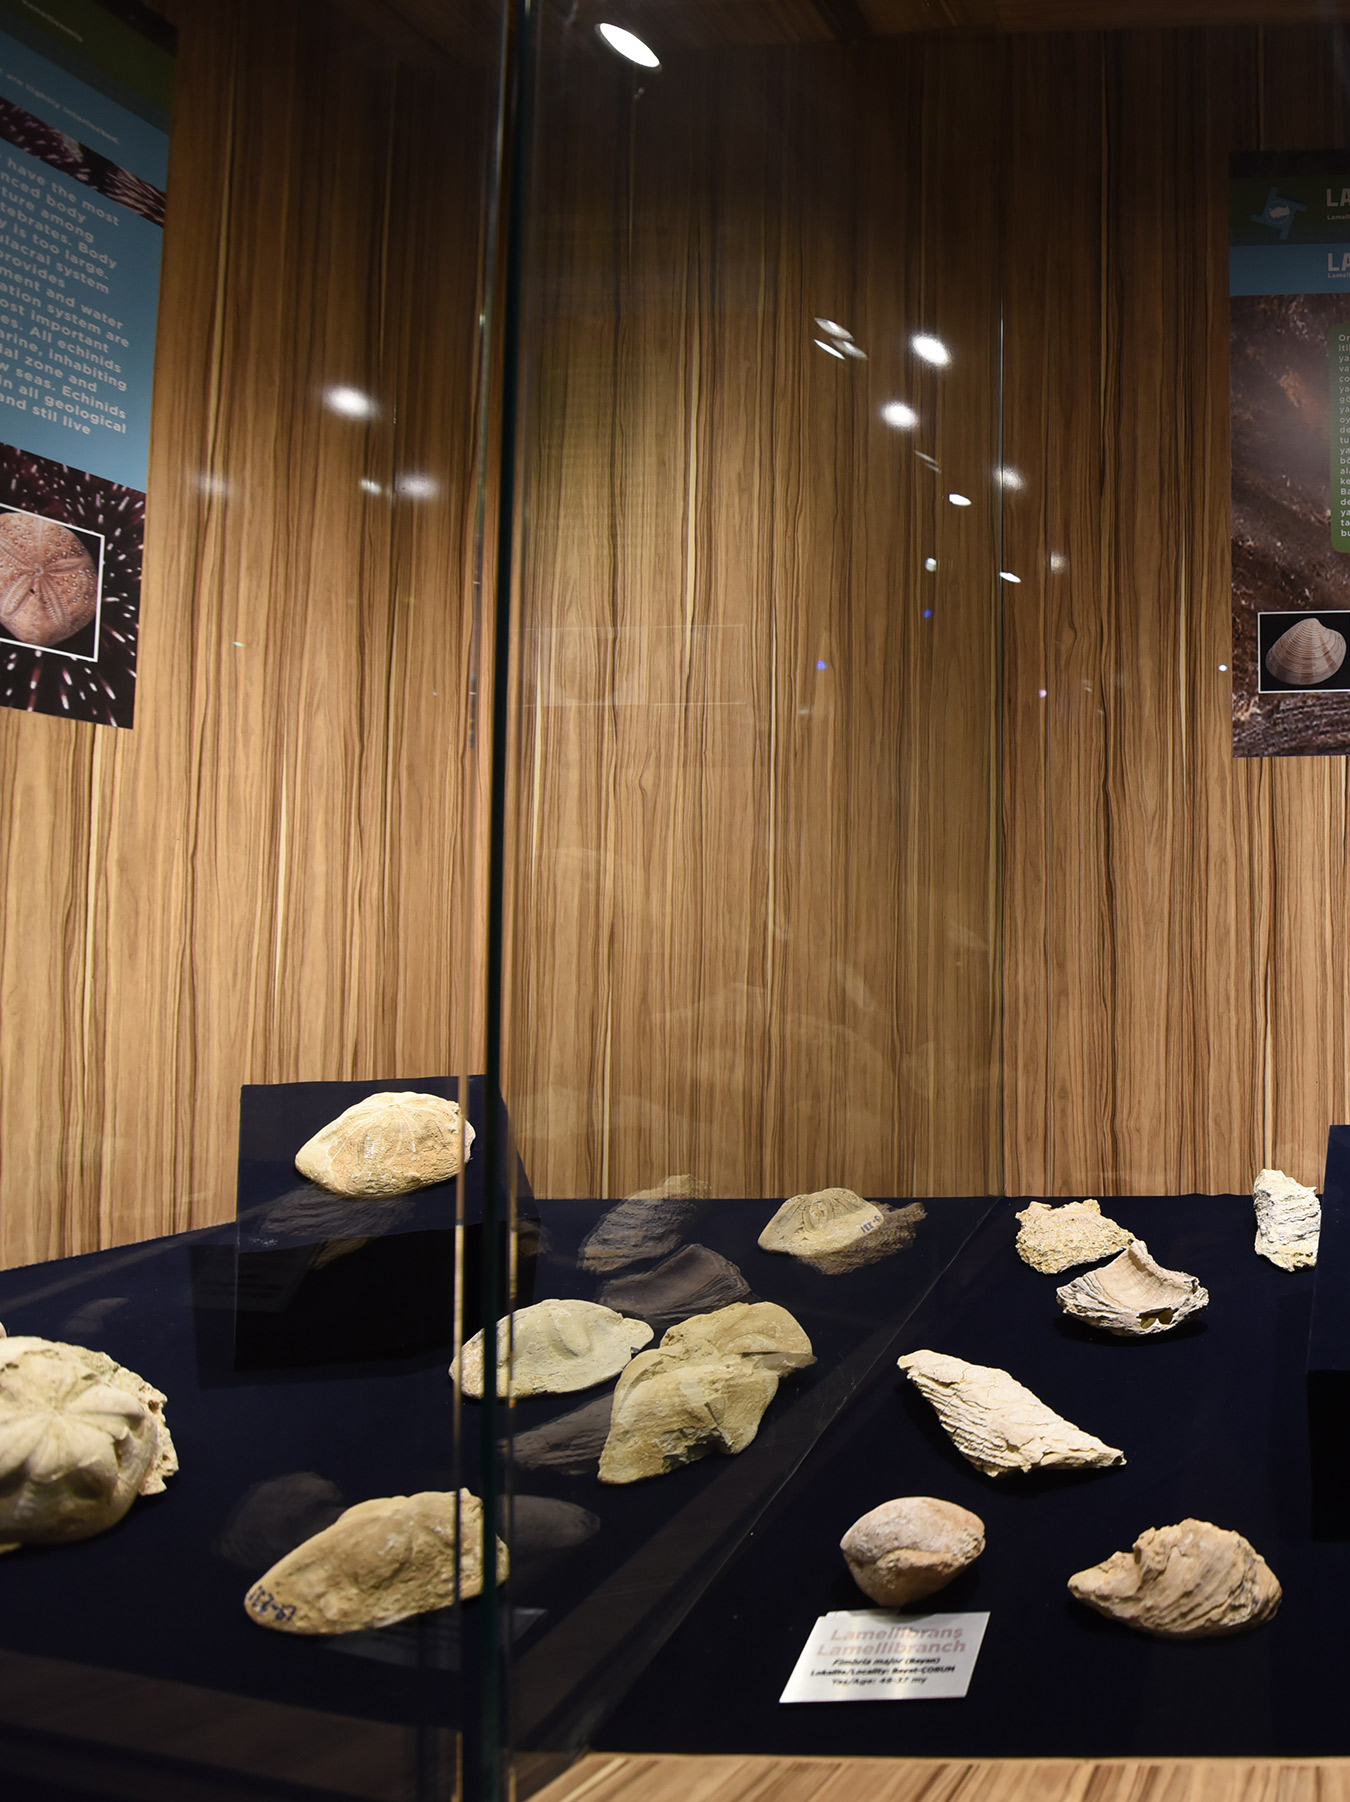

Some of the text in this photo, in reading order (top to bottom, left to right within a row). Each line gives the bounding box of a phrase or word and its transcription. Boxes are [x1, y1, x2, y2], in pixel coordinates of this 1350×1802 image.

[7, 157, 119, 226] have the most
[46, 193, 86, 223] body
[40, 208, 94, 243] among
[0, 234, 109, 294] lacral system
[13, 223, 26, 238] is
[32, 233, 59, 254] too
[64, 249, 108, 279] large.
[78, 241, 117, 269] Body
[46, 288, 75, 307] and
[80, 304, 123, 329] water
[47, 304, 100, 334] system
[105, 331, 129, 347] are
[29, 326, 51, 343] All
[57, 339, 121, 373] echinids
[30, 309, 108, 353] important
[24, 355, 63, 378] zone
[68, 374, 97, 392] and
[48, 348, 126, 391] inhabiting
[15, 368, 125, 419] seas. Echinids
[18, 385, 38, 399] all
[44, 395, 126, 433] geological
[32, 406, 57, 422] stil
[62, 415, 90, 434] live
[817, 1640, 966, 1657] Lamellibranch
